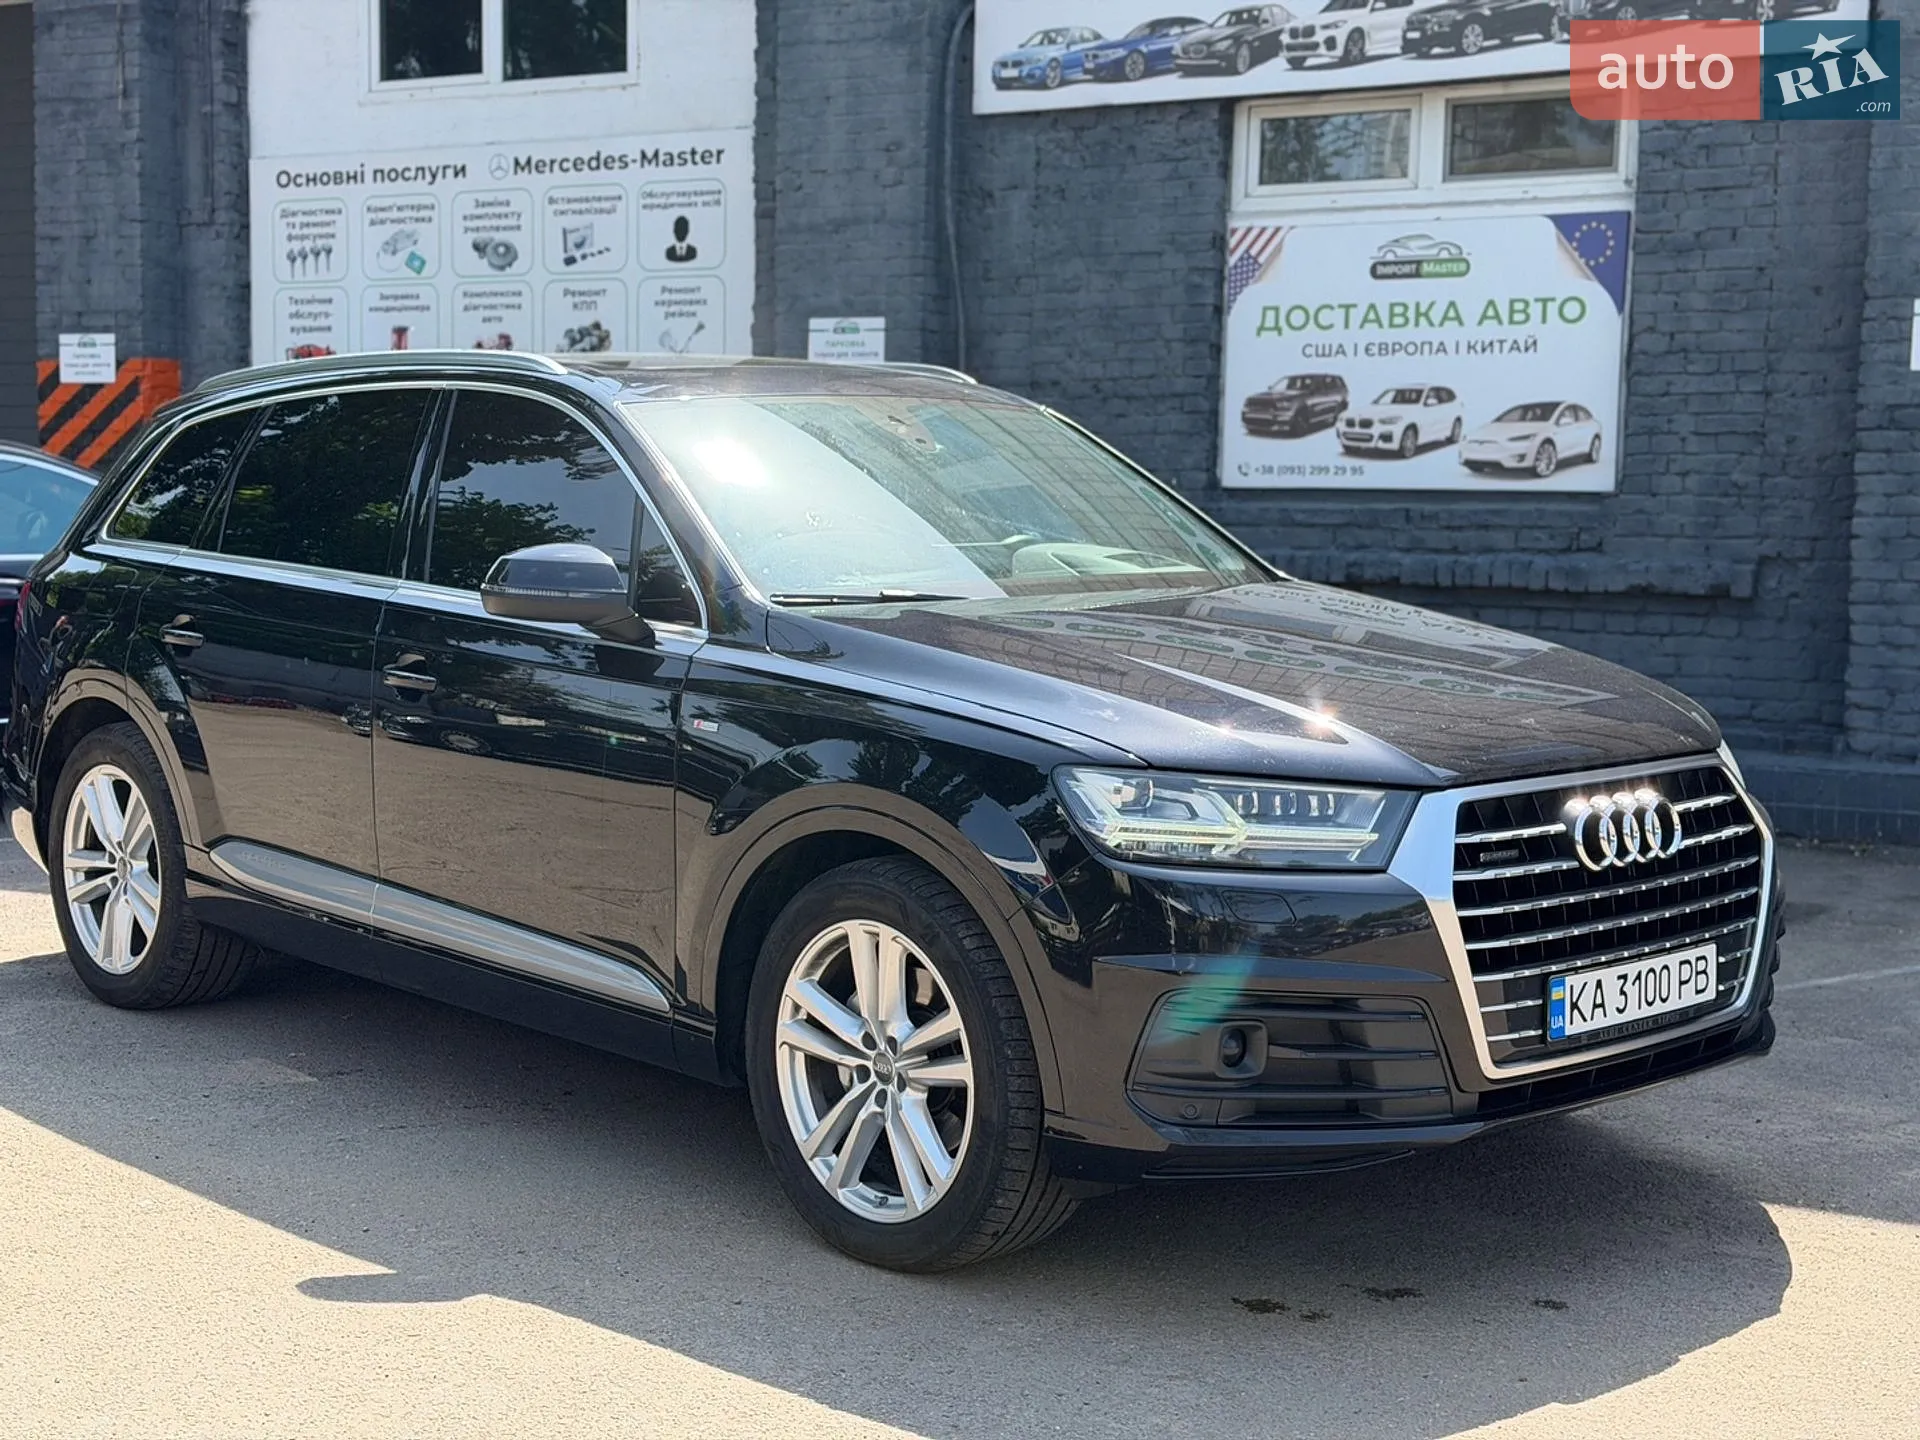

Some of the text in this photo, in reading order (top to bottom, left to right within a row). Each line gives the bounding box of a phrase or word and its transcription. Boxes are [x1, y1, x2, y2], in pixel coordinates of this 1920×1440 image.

[513, 147, 725, 176] Mercedes-Master
[275, 163, 467, 188] Основні послуги
[1256, 295, 1588, 337] ДОСТАВКА АВТО
[1301, 342, 1347, 359] США
[1364, 341, 1448, 359] ЄВРОПА
[1467, 335, 1538, 355] КИТАЙ
[1569, 979, 1608, 1027] KA
[1615, 963, 1671, 1014] 3100
[1677, 955, 1710, 1000] PB
[1551, 1015, 1565, 1030] UA
